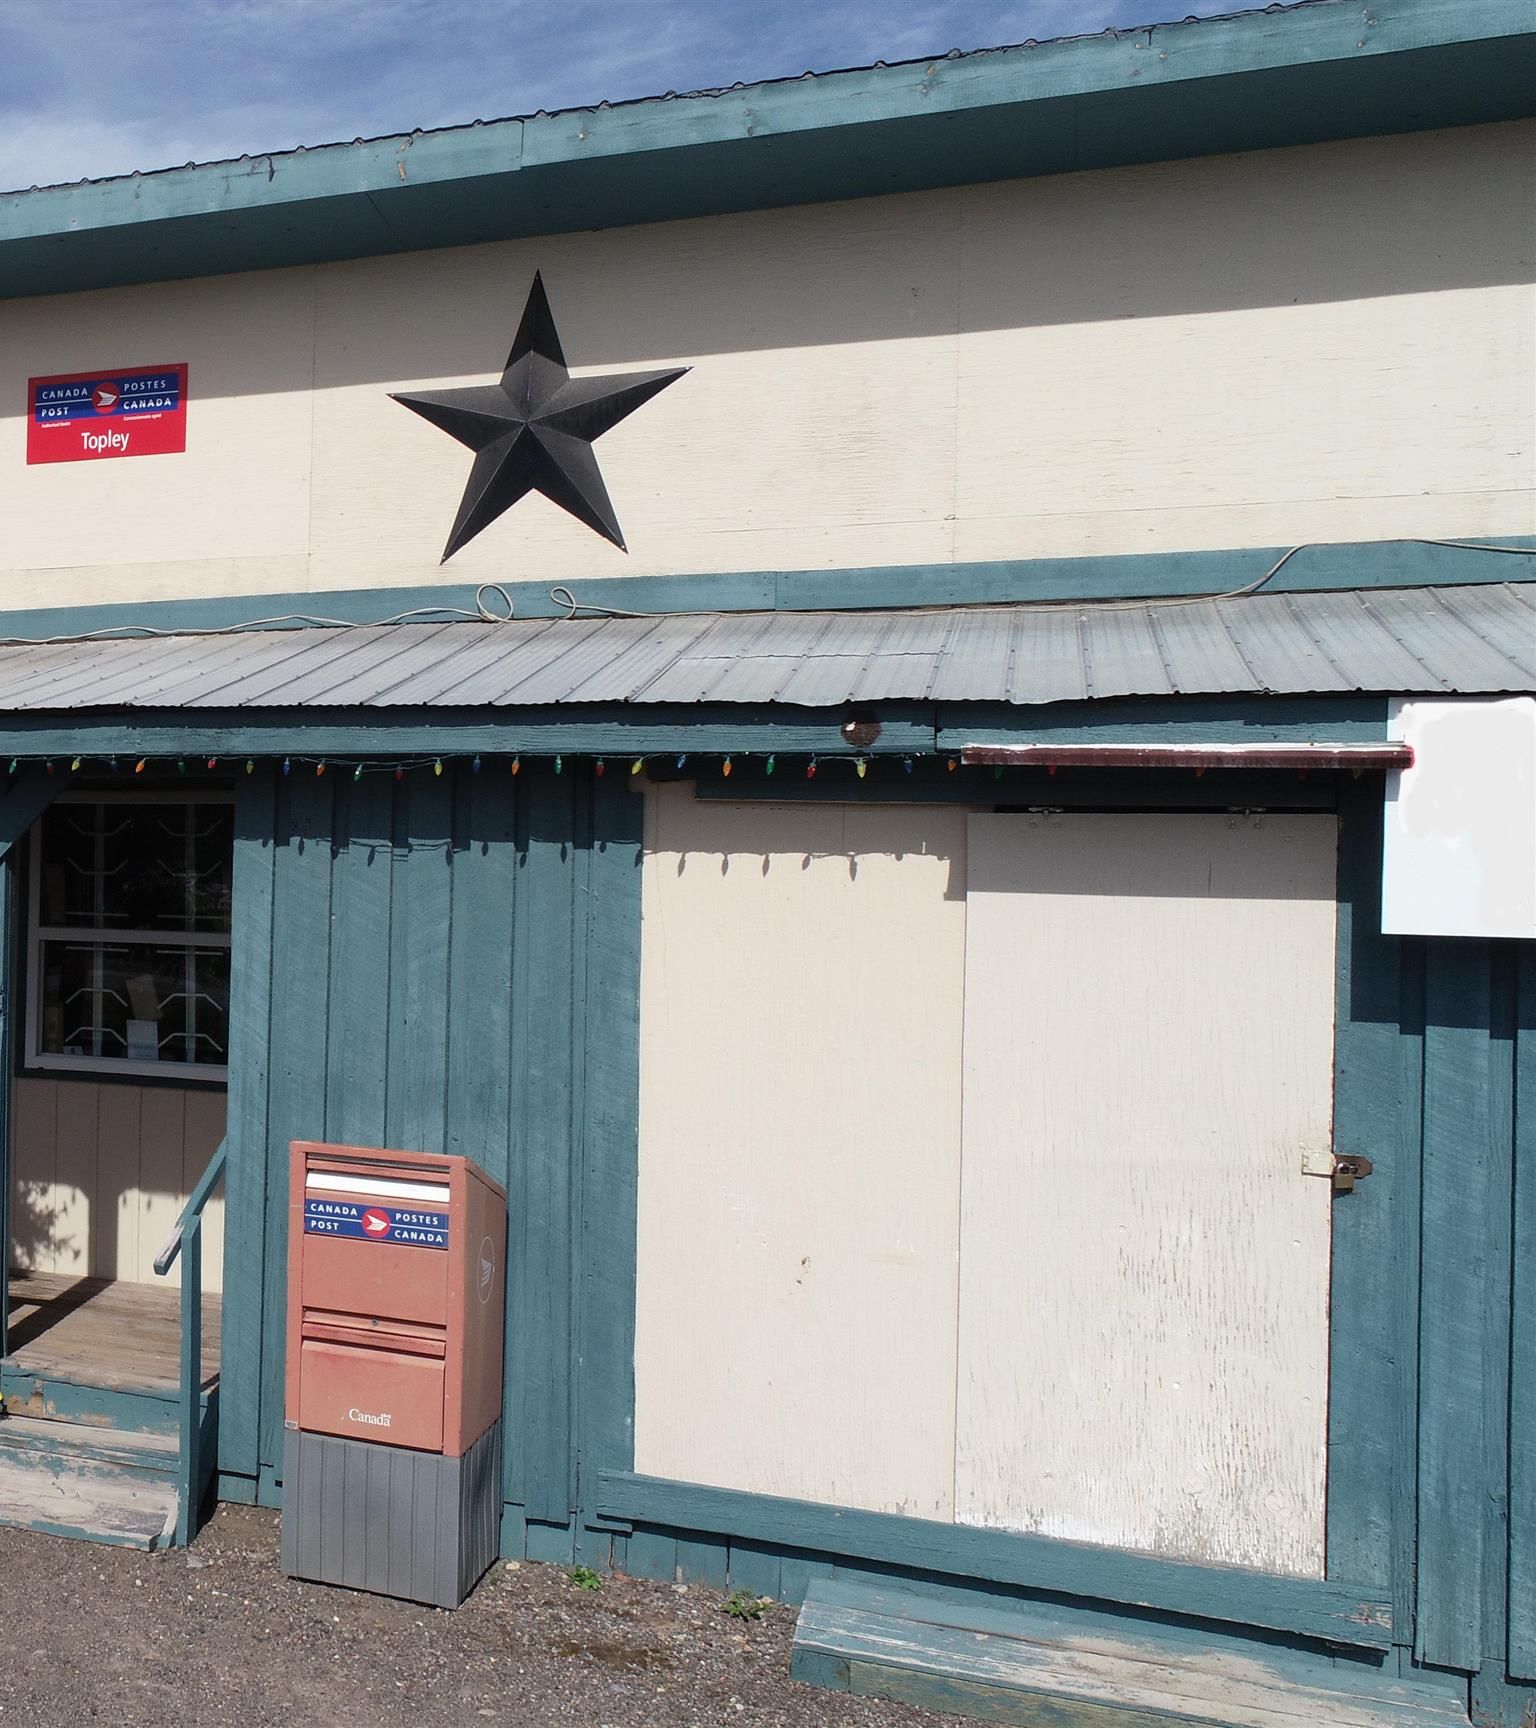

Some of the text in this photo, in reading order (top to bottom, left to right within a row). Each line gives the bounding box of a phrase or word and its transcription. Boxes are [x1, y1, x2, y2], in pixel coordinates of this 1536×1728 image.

[124, 380, 167, 392] POSTES
[42, 388, 89, 400] CANADA
[123, 398, 172, 410] CANADA
[41, 407, 69, 417] POST
[81, 429, 130, 453] Topley
[310, 1203, 357, 1216] CANADA
[395, 1213, 439, 1225] POSTES
[311, 1220, 339, 1231] POST
[394, 1230, 444, 1243] CANADA
[349, 1408, 391, 1427] Canada
